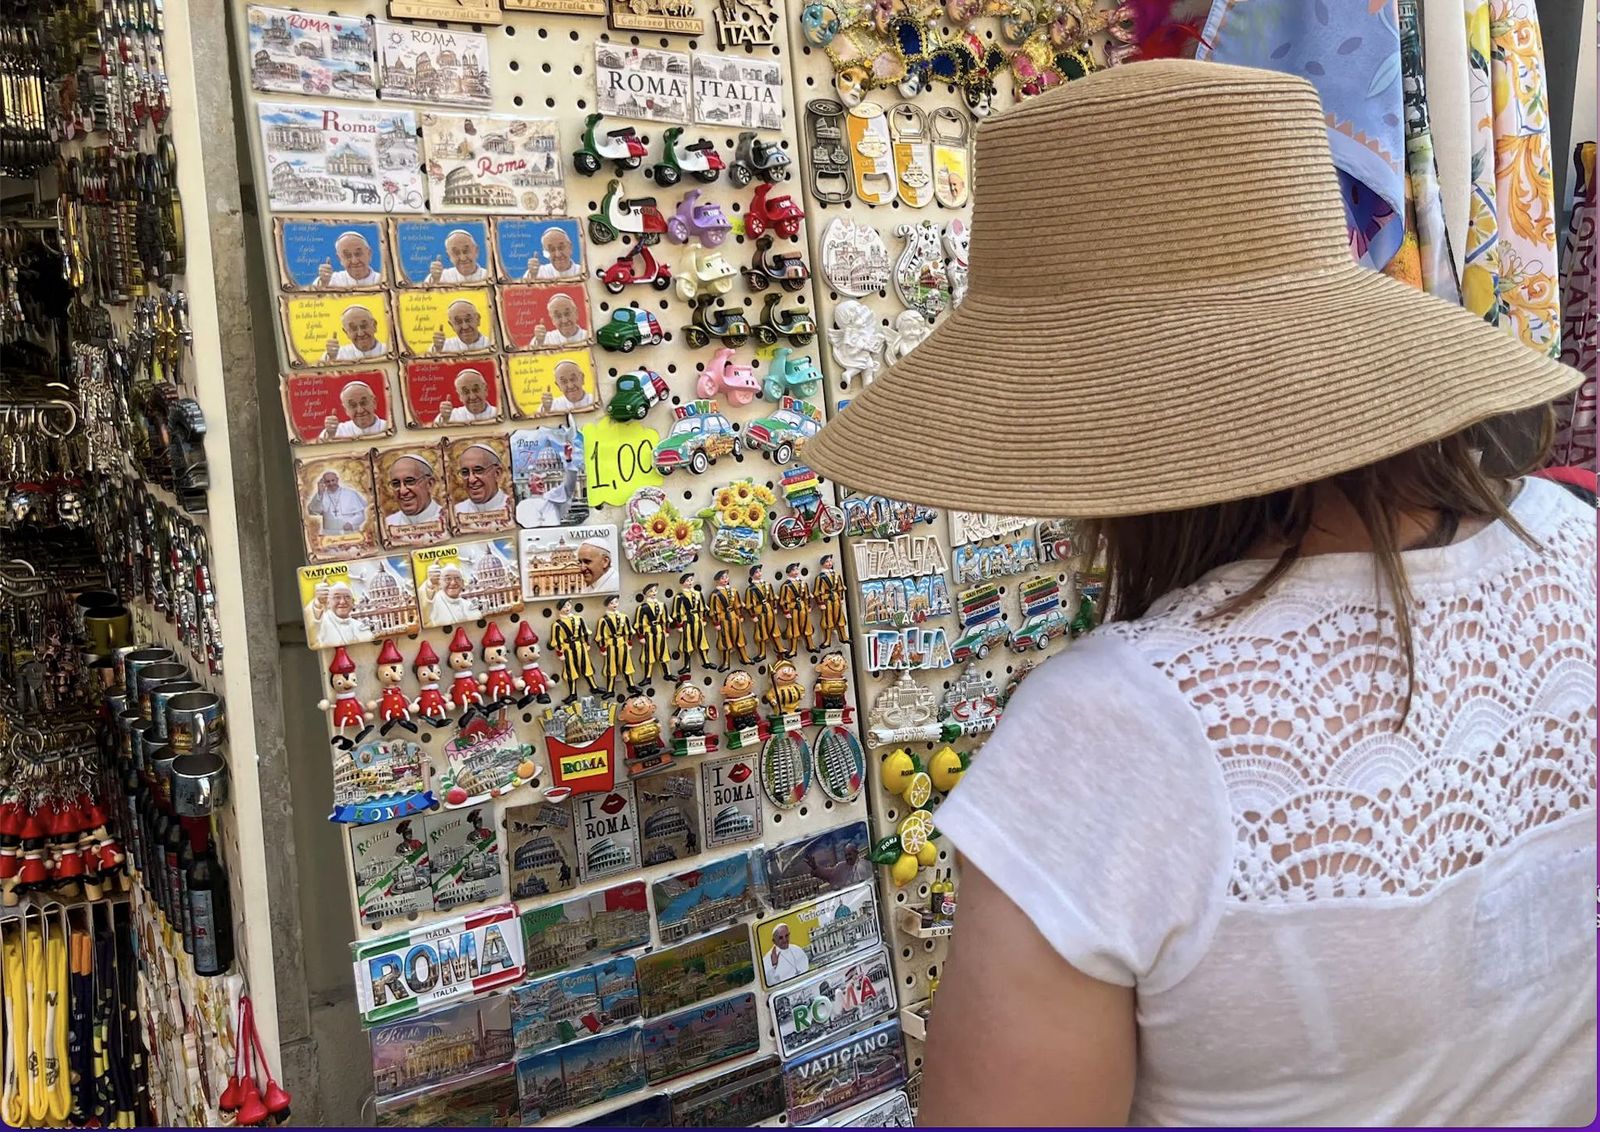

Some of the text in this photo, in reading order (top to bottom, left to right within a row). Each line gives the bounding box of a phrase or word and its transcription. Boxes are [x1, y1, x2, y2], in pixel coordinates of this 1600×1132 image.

[287, 14, 331, 33] ROMA
[668, 20, 702, 32] ROMA
[718, 21, 777, 46] ITALY
[410, 30, 458, 48] ROMA
[607, 70, 684, 98] ROMA
[700, 79, 777, 104] ITALIA
[320, 109, 378, 140] Roma
[477, 157, 528, 179] Roma
[674, 399, 721, 420] ROMA
[783, 396, 824, 422] ROMA
[516, 437, 540, 449] Papa
[590, 438, 655, 490] 1,00
[569, 528, 611, 540] VATICANO
[418, 546, 459, 562] VATICANO
[854, 534, 950, 582] ITALIA
[304, 564, 349, 579] VATICANO
[862, 575, 952, 625] ROMA
[866, 627, 954, 671] ITALIA
[963, 723, 996, 736] ROMA
[562, 755, 607, 776] ROMA
[711, 766, 725, 787] I
[714, 783, 756, 807] ROMA
[583, 799, 597, 821] I
[585, 817, 632, 841] ROMA
[880, 836, 899, 852] ROMA
[799, 902, 837, 922] Vaticano
[425, 927, 452, 941] ITALIA
[368, 922, 516, 1008] ROMA
[432, 985, 459, 1000] ITALIA
[791, 975, 878, 1033] ROMA
[798, 1032, 890, 1080] VATICANO
